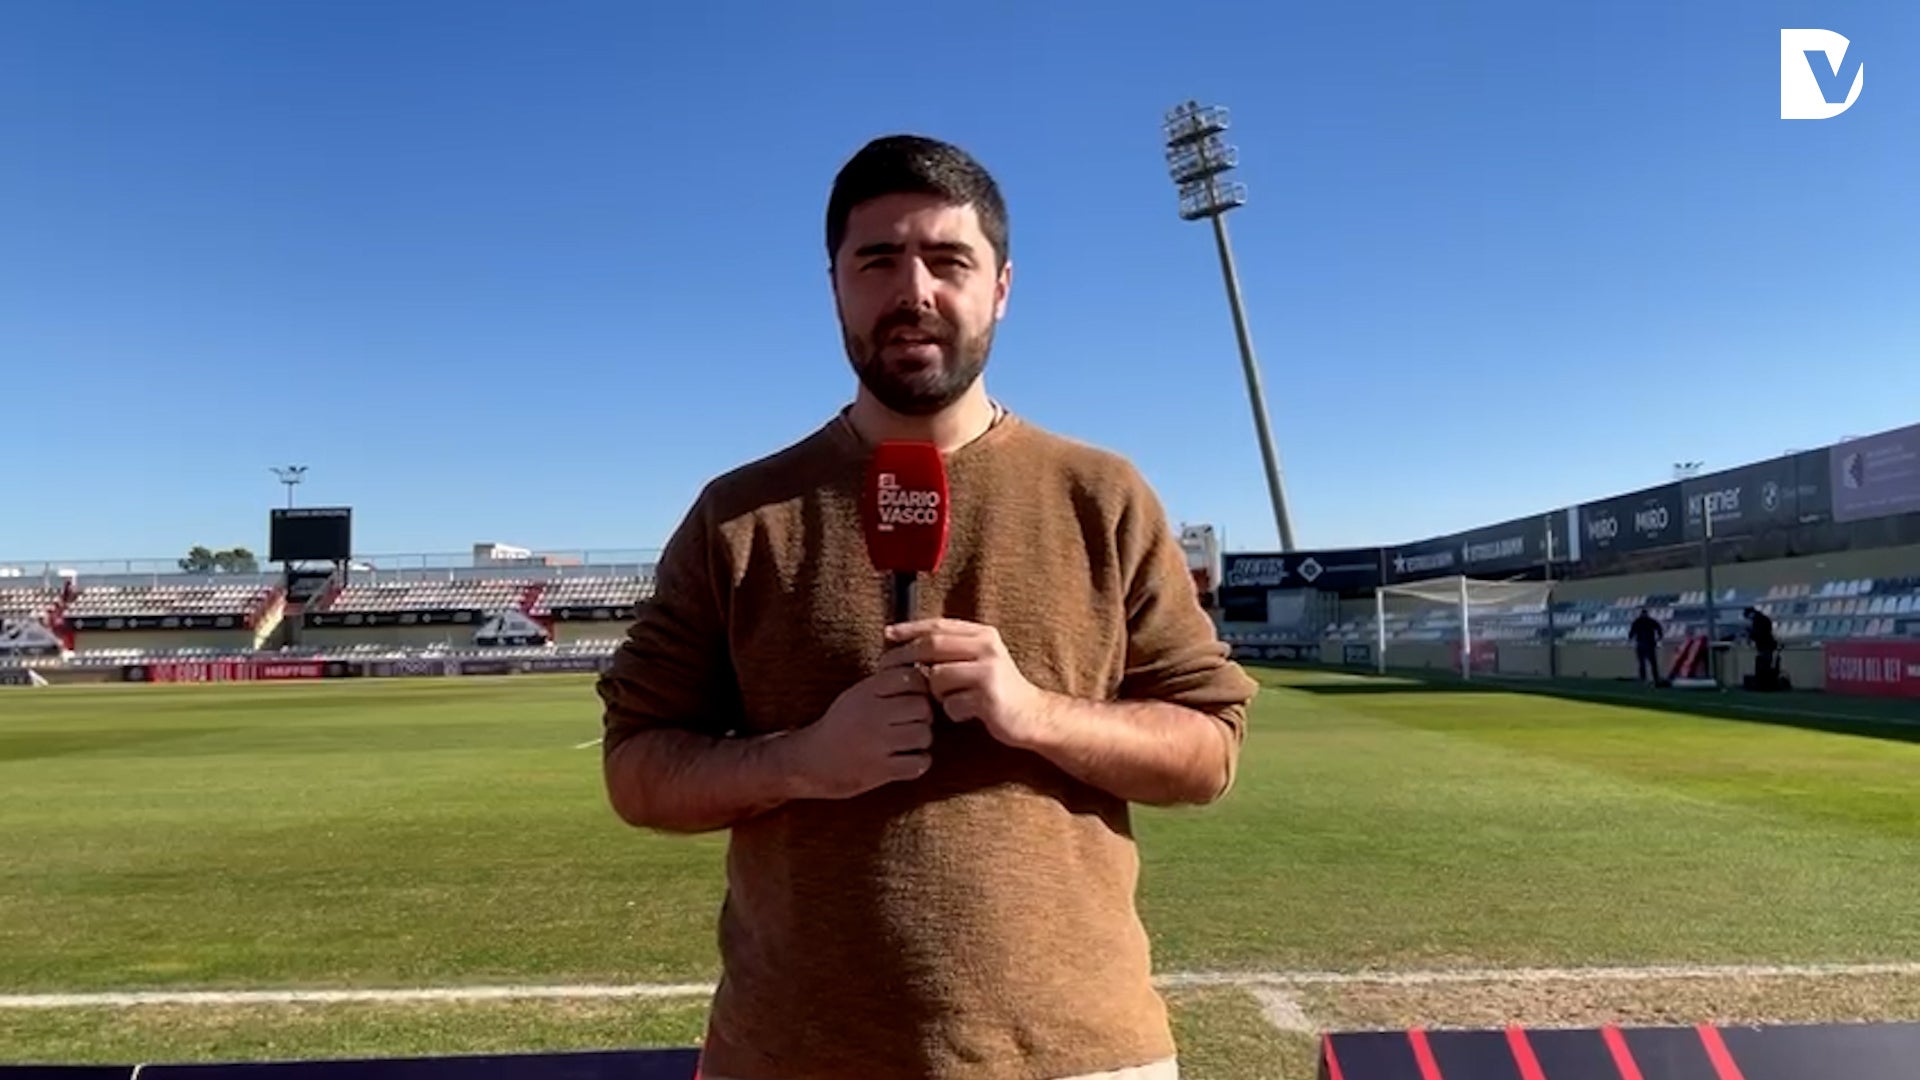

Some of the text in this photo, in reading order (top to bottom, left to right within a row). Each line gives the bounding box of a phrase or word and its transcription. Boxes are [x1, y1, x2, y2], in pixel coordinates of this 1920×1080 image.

[878, 473, 901, 489] EL
[878, 490, 940, 507] DIARIO
[878, 507, 939, 525] VASCO
[1634, 507, 1669, 533] MIRO
